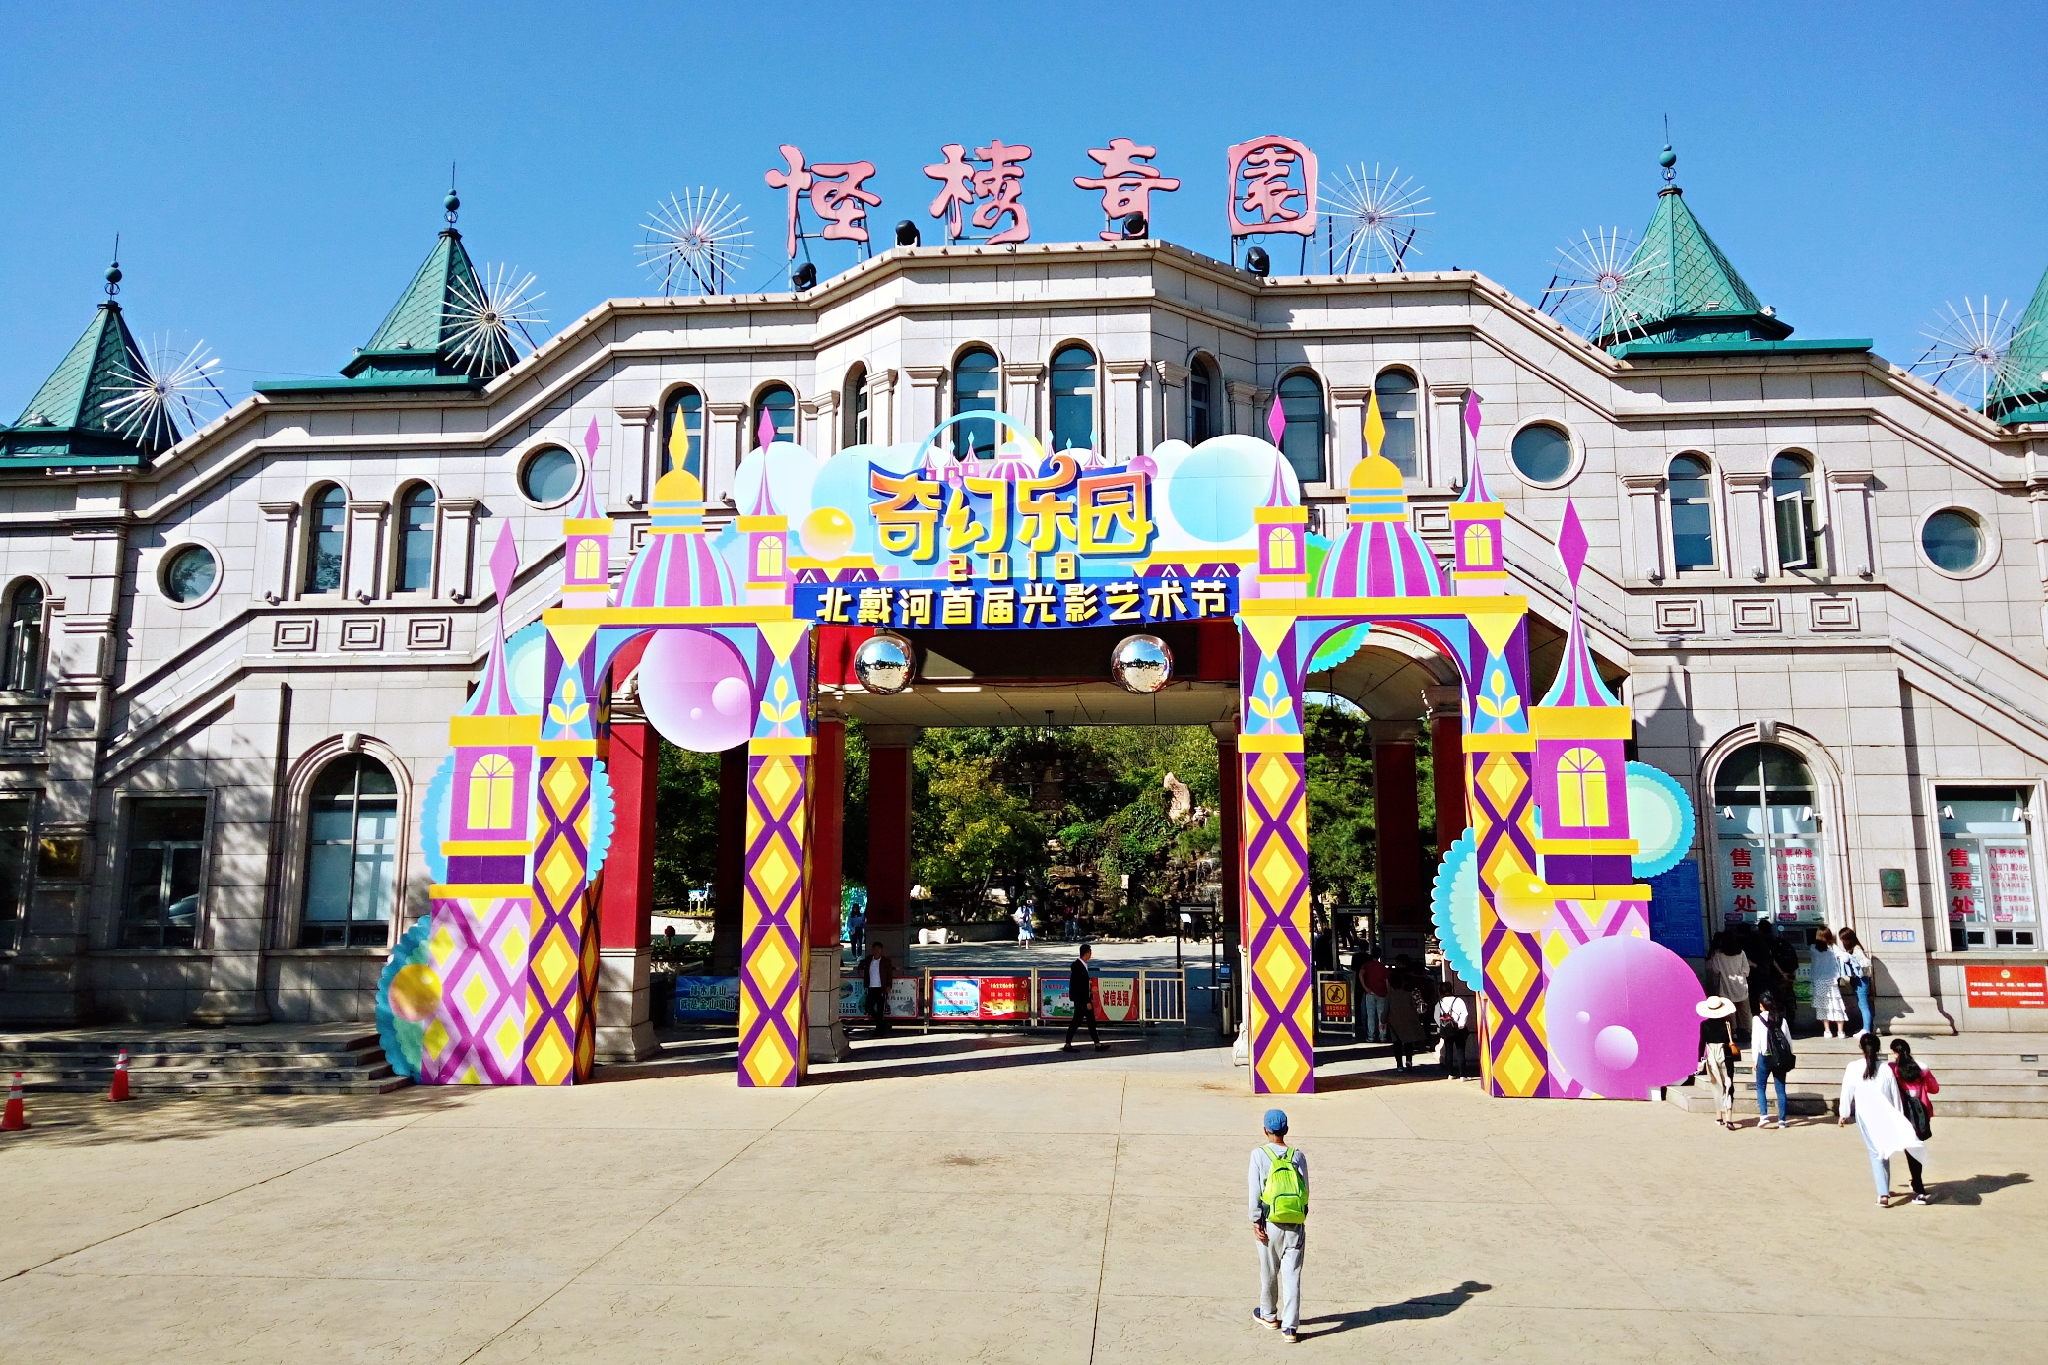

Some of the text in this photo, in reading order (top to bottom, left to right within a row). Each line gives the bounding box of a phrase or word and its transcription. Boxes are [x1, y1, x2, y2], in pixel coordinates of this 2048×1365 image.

[870, 456, 1156, 560] 奇幻乐园
[947, 553, 1080, 582] 2018
[816, 580, 1228, 626] 北戴河首届光影艺术节
[1775, 848, 1813, 858] 门票价格
[1988, 848, 2026, 858] 门票价格
[1730, 848, 1757, 913] 售票处
[1947, 848, 1975, 915] 售票处
[690, 984, 727, 996] 绿水青山
[1103, 990, 1129, 1006] 诚信是福
